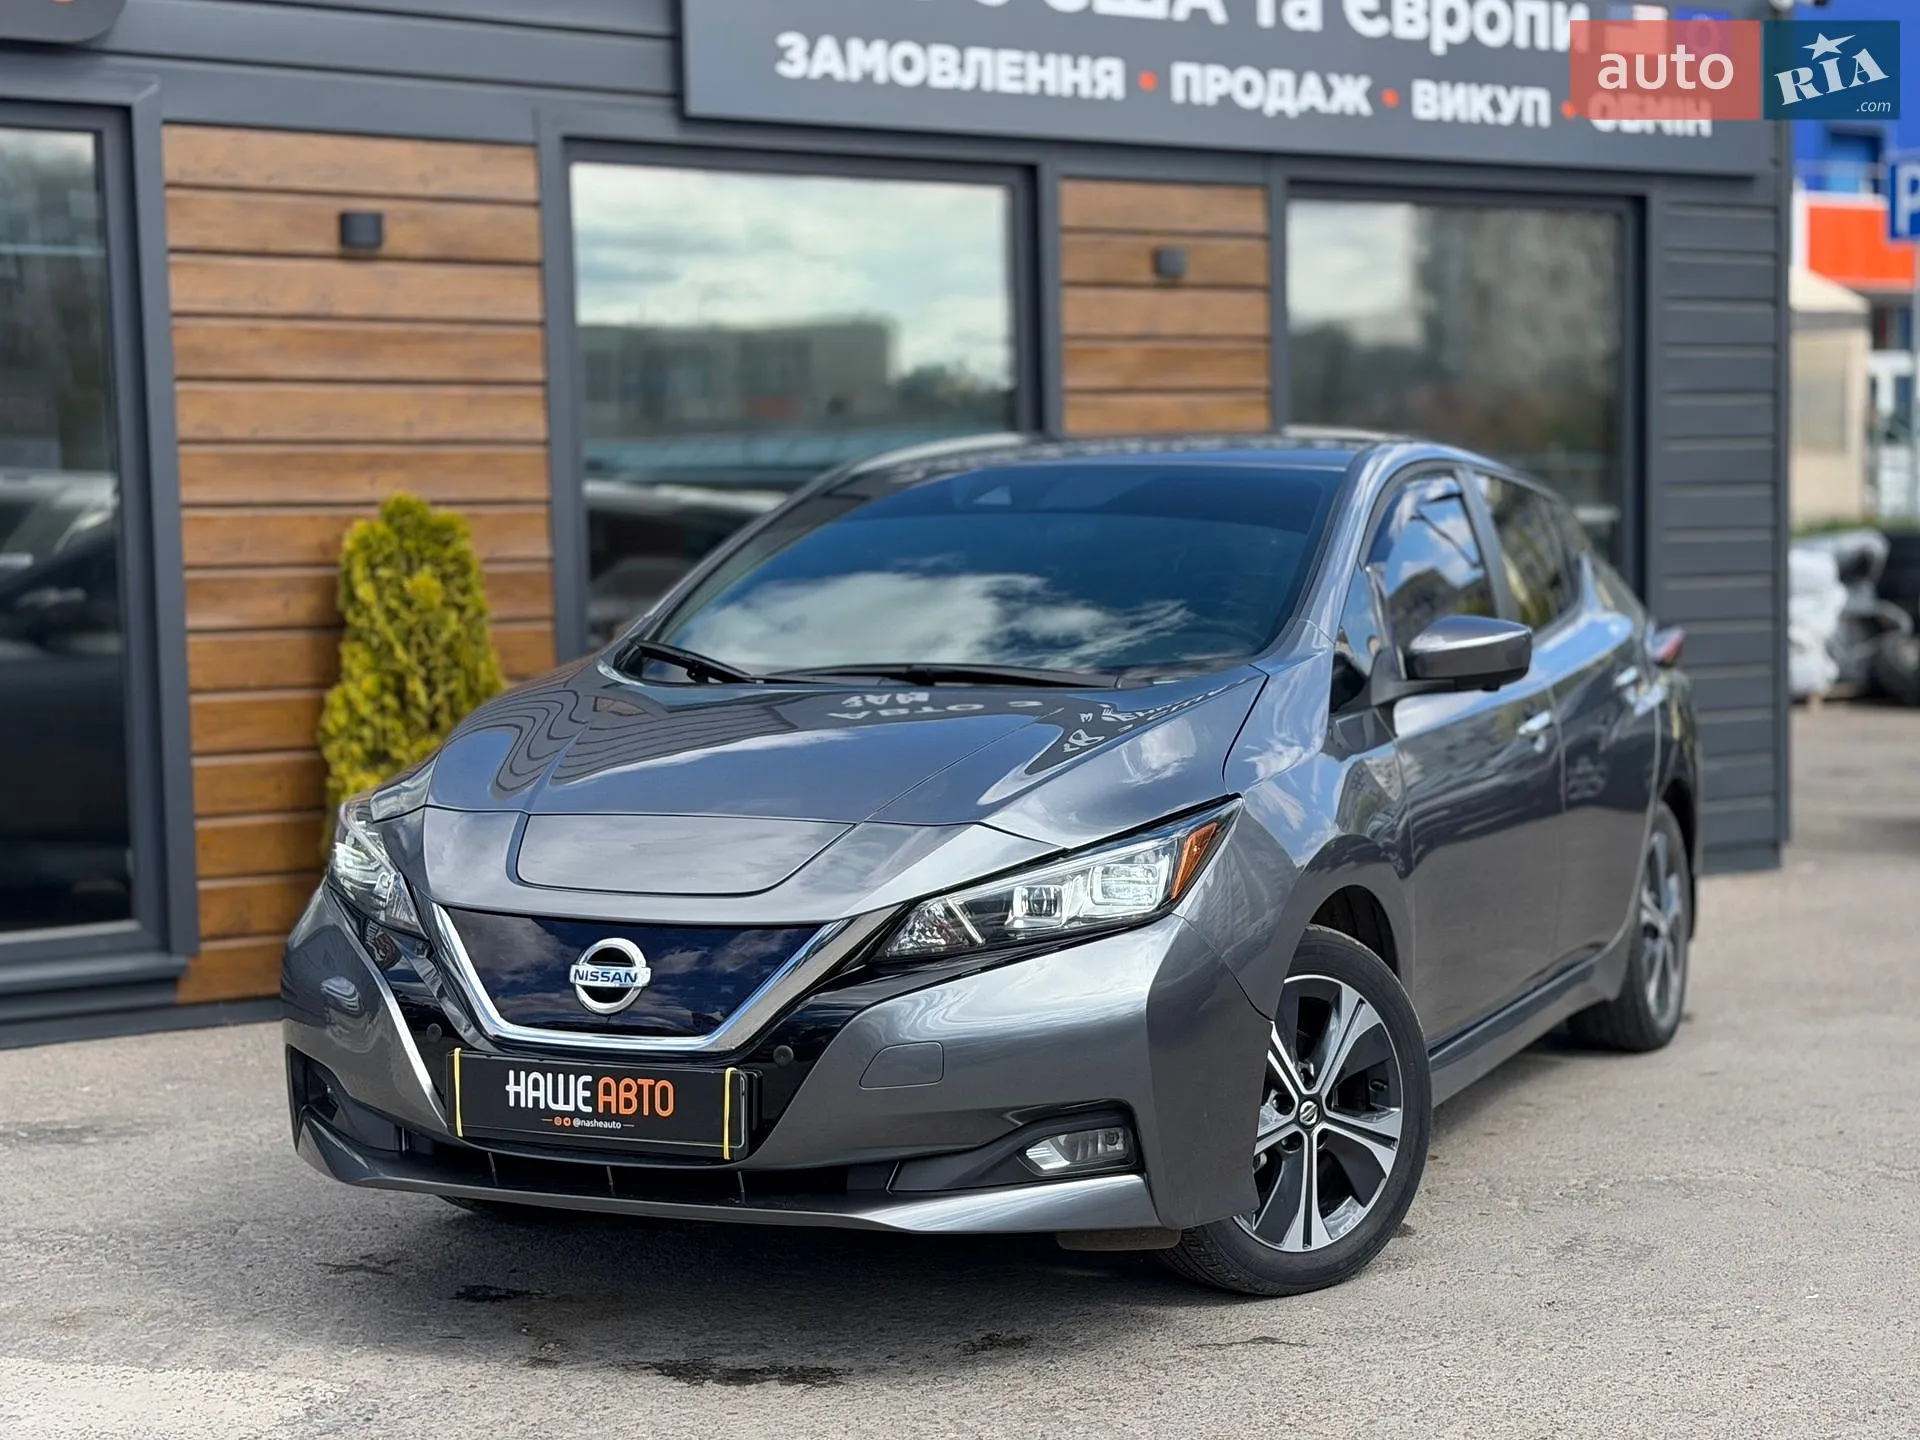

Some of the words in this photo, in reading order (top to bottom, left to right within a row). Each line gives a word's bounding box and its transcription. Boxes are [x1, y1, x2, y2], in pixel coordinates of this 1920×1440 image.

[774, 31, 1126, 100] ЗАМОВЛЕННЯ
[1170, 61, 1374, 119] ПРОДАЖ
[1411, 78, 1552, 128] ВИКУП
[573, 968, 639, 984] NISSAN
[505, 1069, 593, 1113] НАШЕ
[597, 1076, 675, 1118] АВТО
[572, 1117, 622, 1129] @nasheauto
